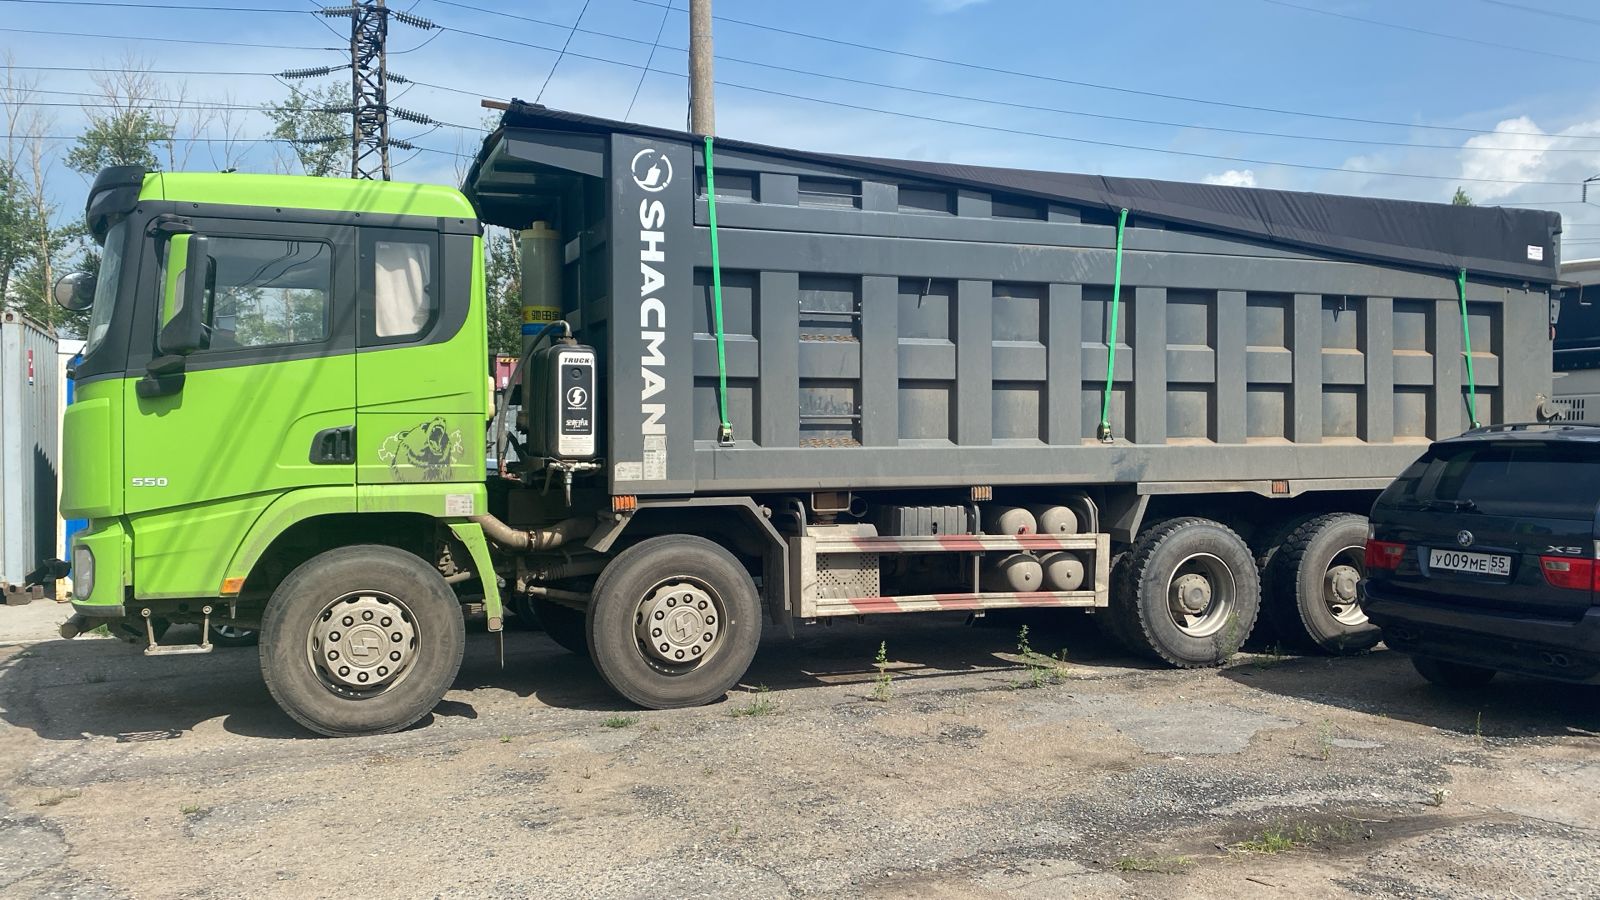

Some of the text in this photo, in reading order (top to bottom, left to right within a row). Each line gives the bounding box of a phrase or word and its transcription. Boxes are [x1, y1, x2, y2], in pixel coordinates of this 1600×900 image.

[639, 198, 666, 435] SHACMAN
[132, 477, 168, 487] 550
[1545, 545, 1583, 554] X5
[1491, 556, 1506, 568] 55
